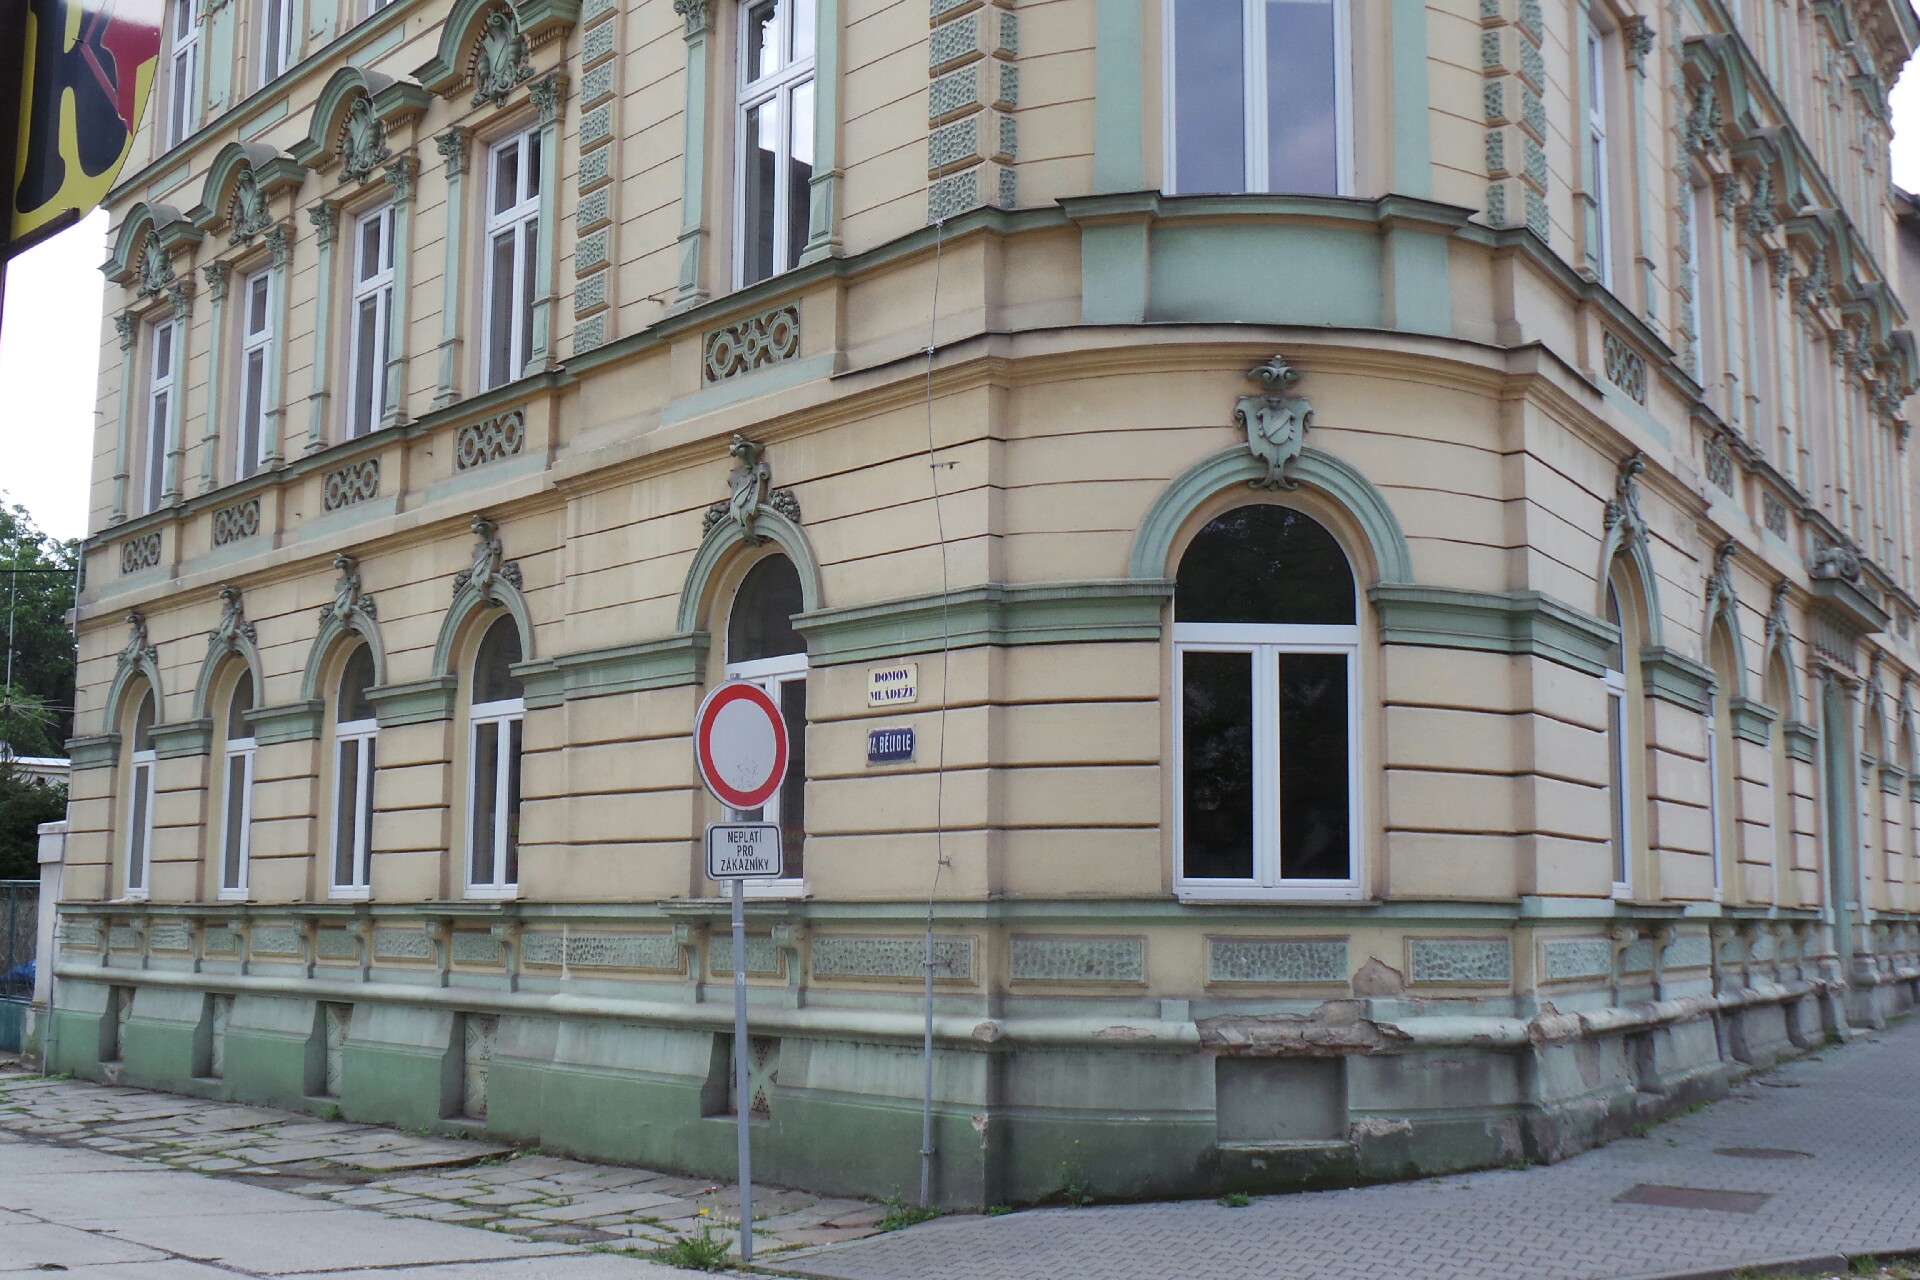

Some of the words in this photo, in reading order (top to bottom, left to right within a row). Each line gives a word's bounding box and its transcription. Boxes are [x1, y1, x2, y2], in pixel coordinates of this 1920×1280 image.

[875, 669, 909, 683] DOMOV
[870, 684, 915, 701] MLÁDEŽE
[880, 732, 911, 754] BĚLIDLE
[727, 829, 762, 843] NEPLATÍ
[737, 845, 754, 857] PRO
[720, 857, 769, 872] ZÁKAZNÍKY
